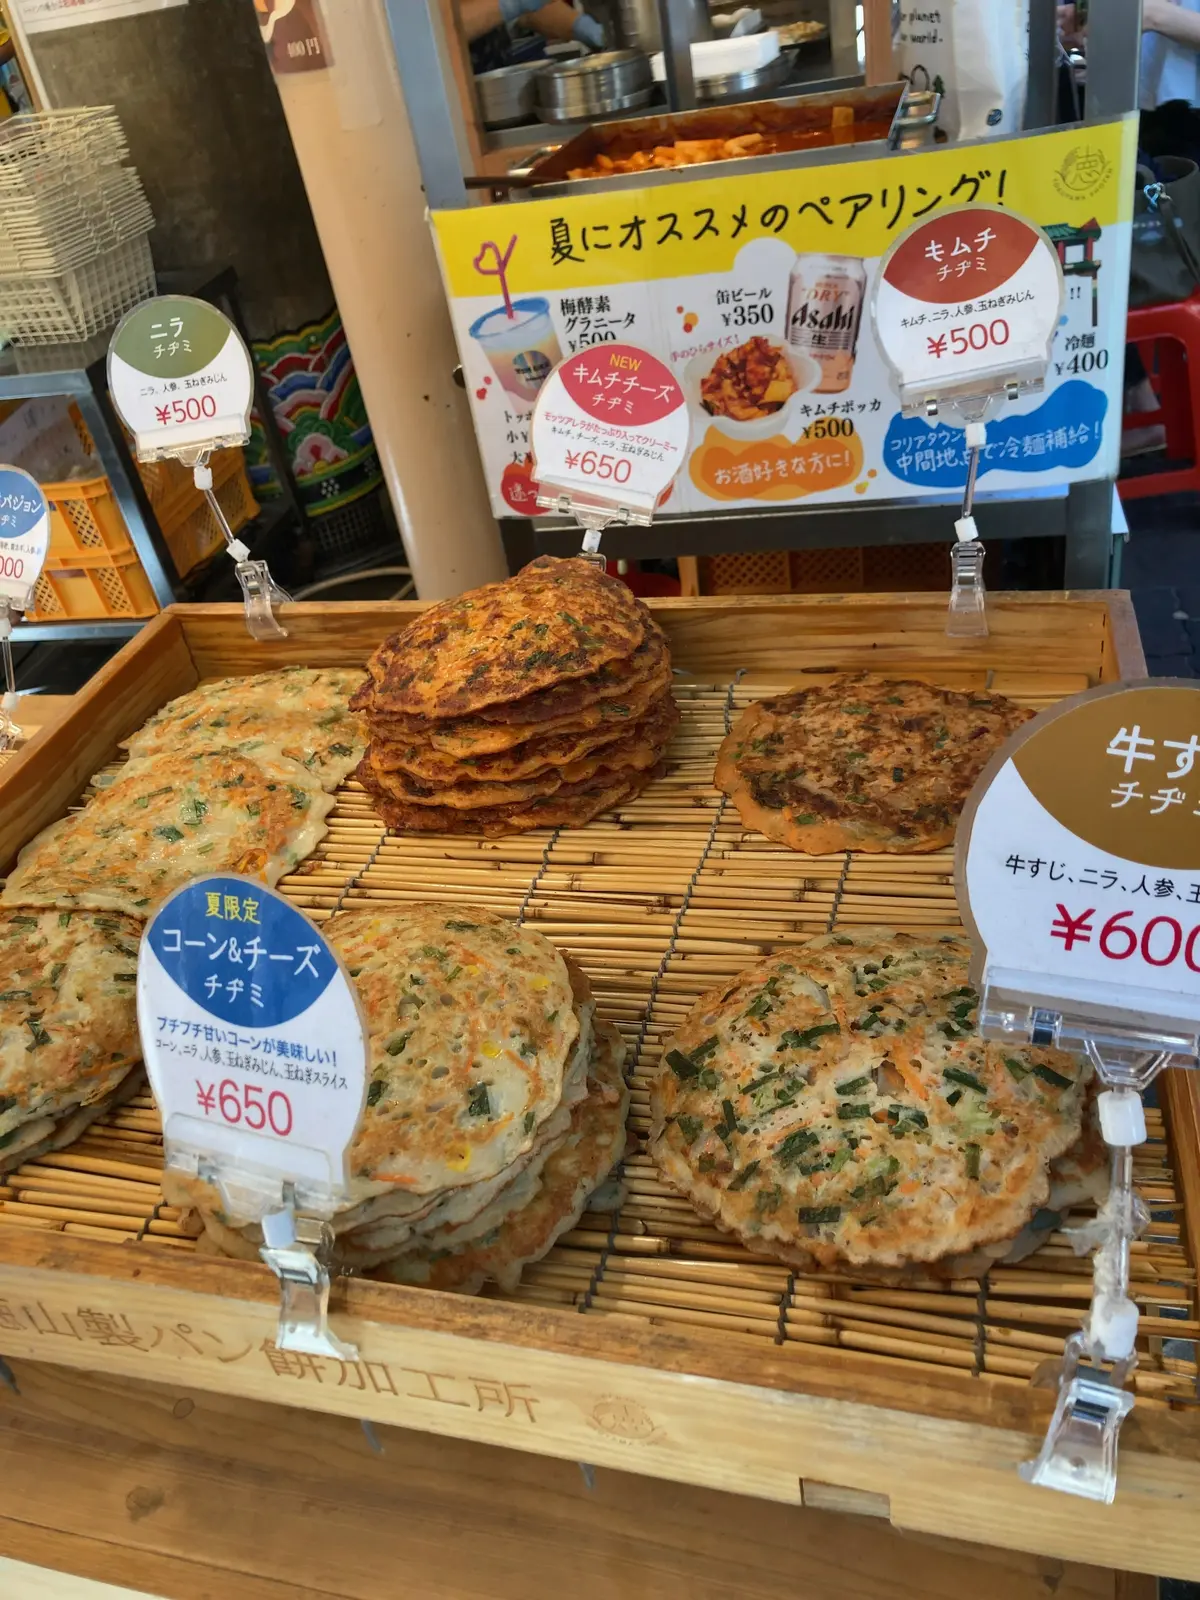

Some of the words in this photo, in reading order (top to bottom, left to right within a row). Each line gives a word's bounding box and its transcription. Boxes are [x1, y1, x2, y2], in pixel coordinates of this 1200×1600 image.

[550, 169, 1007, 266] 夏にオススメのペアリング!
[924, 227, 997, 262] キムチ
[936, 256, 987, 282] チヂミ
[560, 295, 611, 317] 梅酵素
[715, 287, 773, 305] 缶ビール
[900, 289, 1035, 329] キムチ、ニラ、人参、玉ねぎみじん
[150, 317, 184, 339] ニラ
[565, 312, 636, 334] グラニータ
[721, 303, 774, 327] ¥350
[791, 302, 855, 331] Asahi
[153, 340, 193, 359] チヂミ
[926, 318, 1010, 359] ¥500
[609, 353, 642, 372] NEW
[1055, 349, 1109, 376] ¥400
[140, 373, 228, 397] ニラ、人参、玉ねぎみじん
[573, 363, 675, 404] キムチチーズ
[155, 394, 217, 425] ¥500
[592, 392, 634, 415] チヂミ
[802, 418, 854, 440] ¥500
[890, 429, 967, 452] コリアタウン
[564, 449, 632, 484] ¥650
[714, 450, 851, 485] お酒好きな方に!
[0, 493, 42, 514] パジョン
[0, 514, 17, 528] ヂミ
[1106, 724, 1200, 779] 牛す
[204, 891, 261, 925] 夏限定
[163, 928, 322, 979] コーン&チーズ
[204, 973, 265, 1008] チヂミ
[195, 1078, 293, 1137] ¥650
